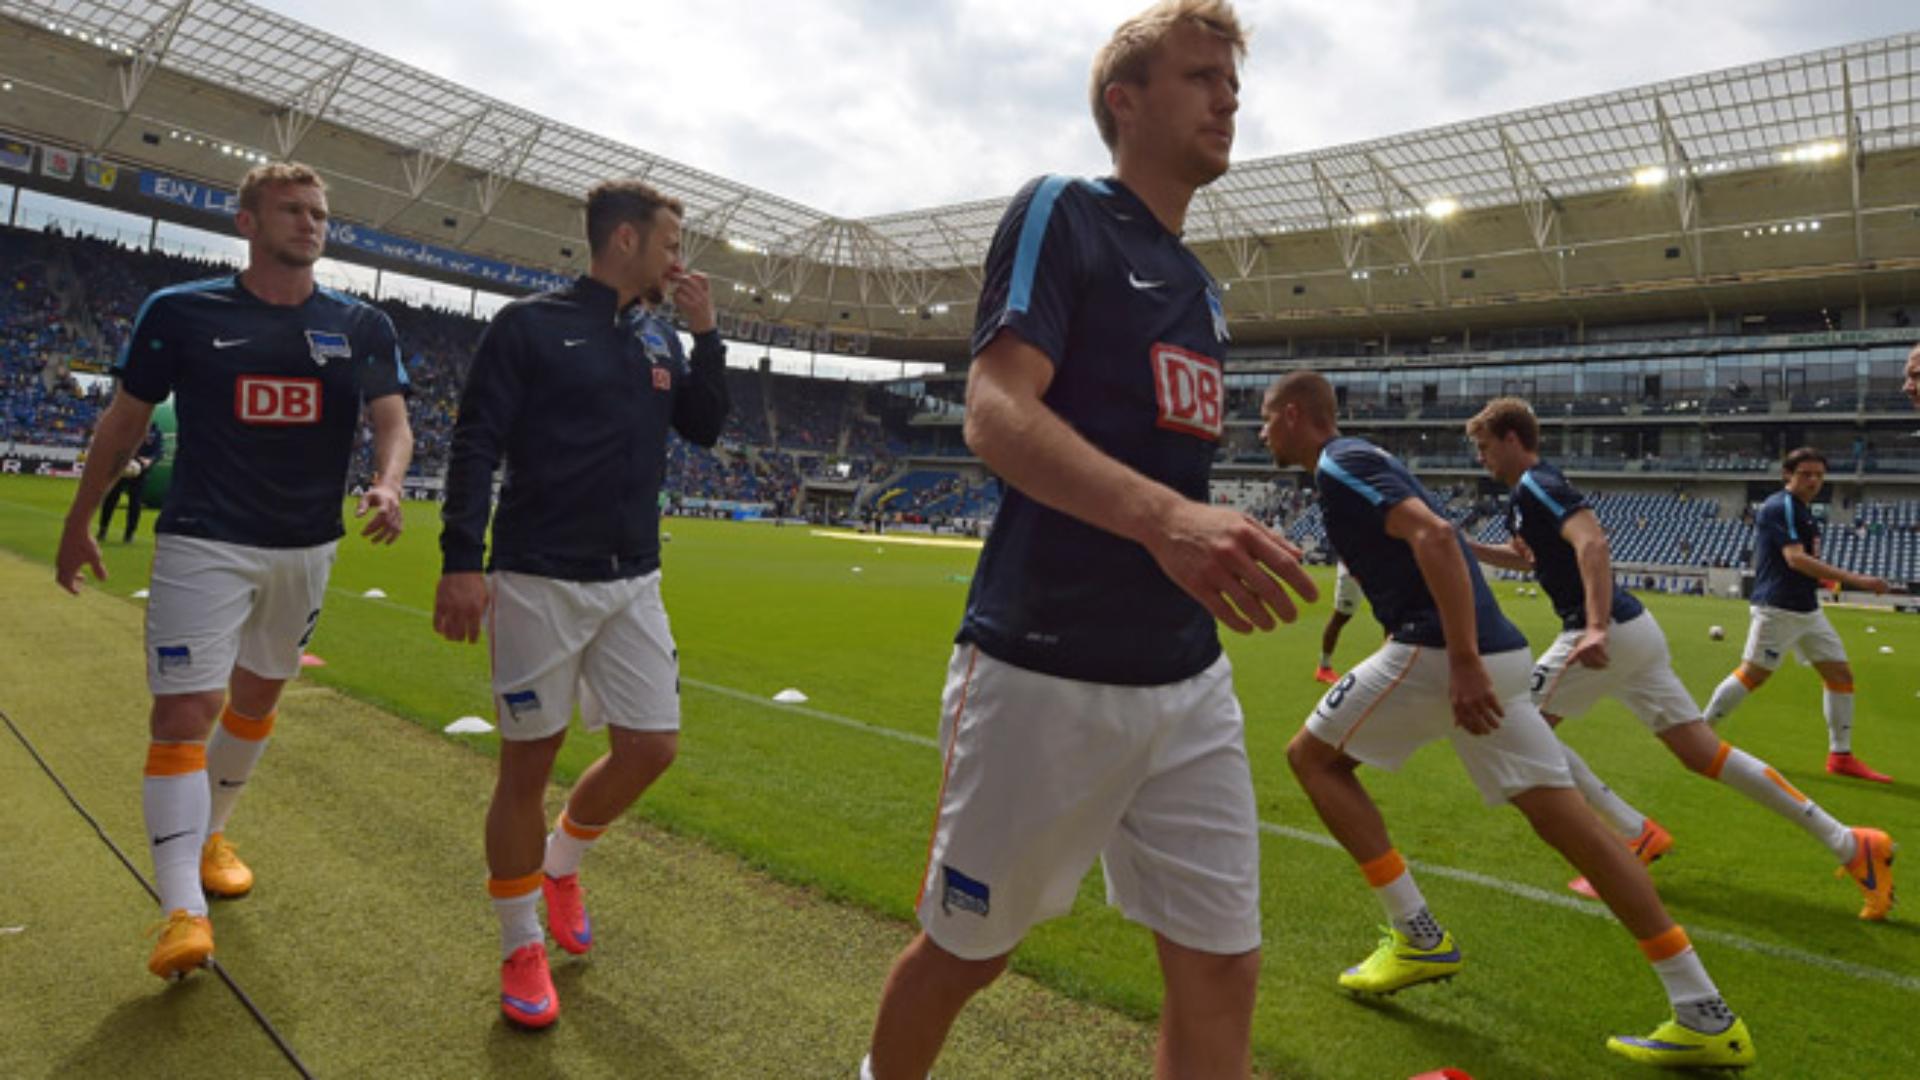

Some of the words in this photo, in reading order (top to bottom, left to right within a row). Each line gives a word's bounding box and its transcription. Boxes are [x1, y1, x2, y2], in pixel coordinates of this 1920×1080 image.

[205, 189, 240, 213] LE
[326, 222, 356, 244] NG
[248, 383, 311, 418] DB
[1165, 357, 1219, 427] DB
